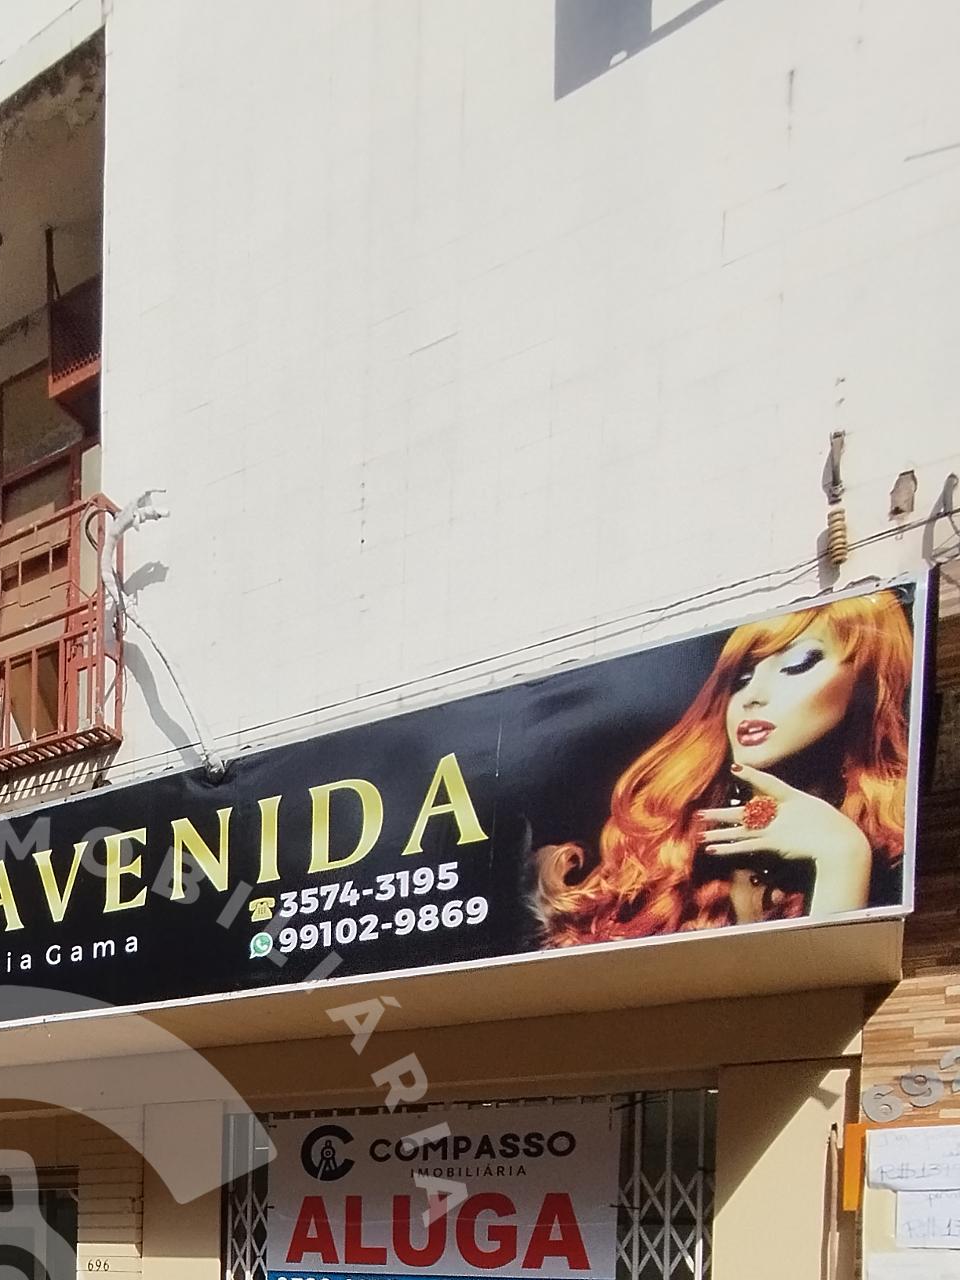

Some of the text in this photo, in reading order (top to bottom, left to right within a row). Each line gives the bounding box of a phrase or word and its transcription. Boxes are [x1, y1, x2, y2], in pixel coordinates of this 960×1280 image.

[279, 861, 460, 918] 3574-3195
[278, 896, 489, 953] 99102-9869
[45, 935, 139, 966] Gama
[368, 1130, 577, 1165] COMPASSO
[410, 1163, 528, 1179] IMOBILIÁRIA
[285, 1192, 592, 1271] ALUGA
[87, 1259, 110, 1272] 696
